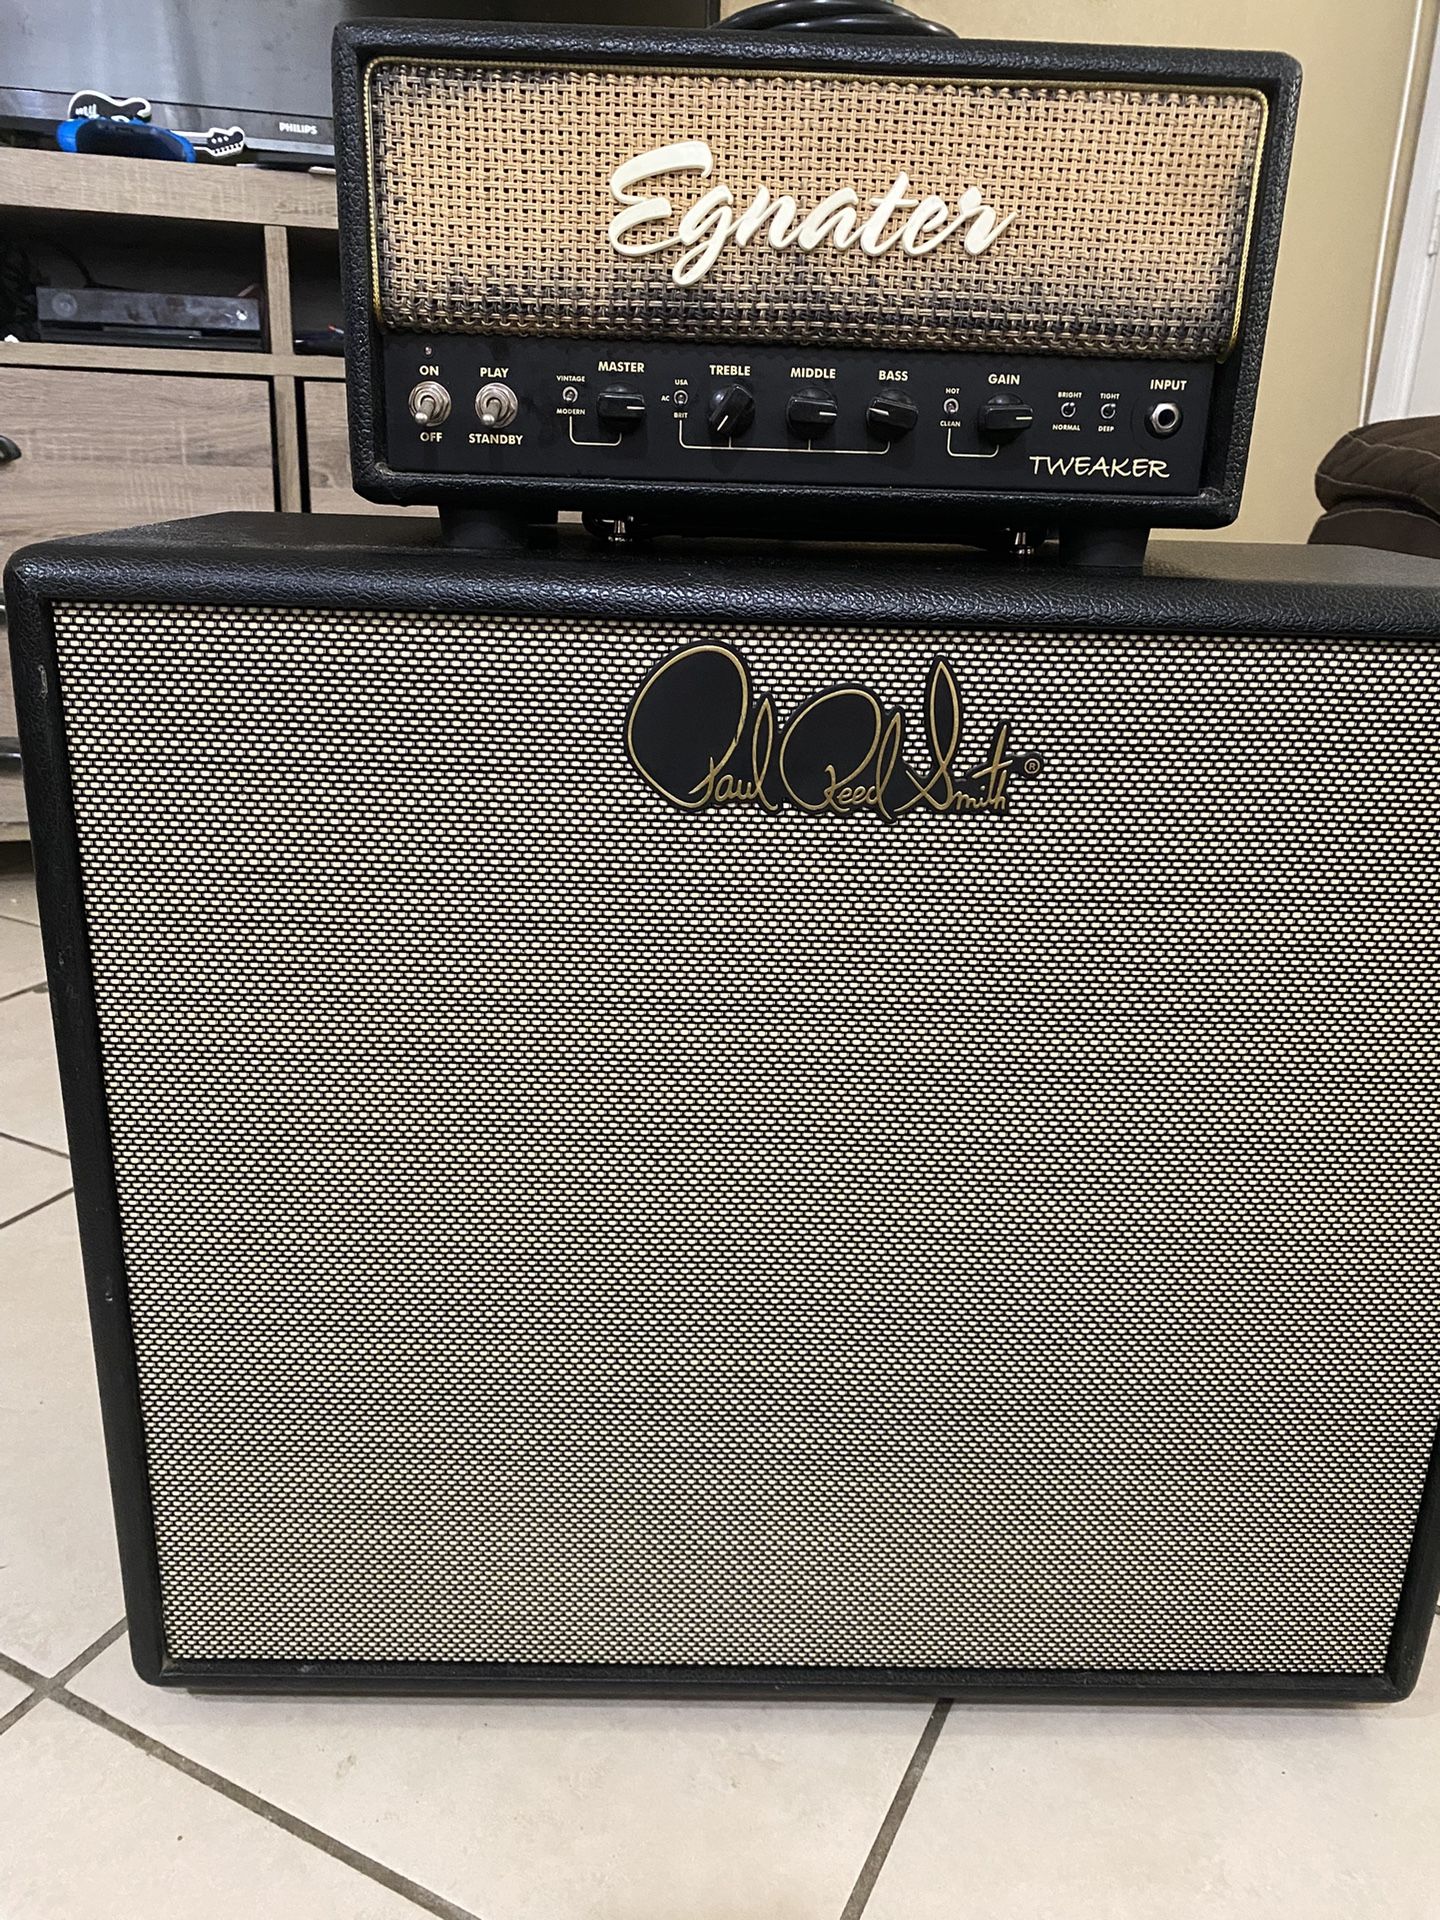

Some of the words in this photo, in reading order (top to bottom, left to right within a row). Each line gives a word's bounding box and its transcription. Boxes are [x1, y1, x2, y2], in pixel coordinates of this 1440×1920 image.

[278, 121, 318, 135] PHILIPS
[608, 140, 1017, 287] Egnater
[419, 365, 439, 377] ON
[480, 367, 509, 378] PLAY
[597, 361, 645, 373] MASTER
[709, 364, 751, 377] TREBLE
[790, 367, 836, 379] MIDDLE
[556, 375, 586, 383] VINTAGE
[878, 370, 909, 382] BASS
[988, 373, 1021, 385] GAIN
[945, 387, 960, 395] HOT
[1149, 379, 1188, 391] INPUT
[1057, 391, 1083, 399] BRIGHT
[1100, 392, 1120, 400] TIGHT
[556, 408, 586, 416] MODERN
[673, 412, 688, 420] BRIT
[939, 420, 961, 429] CLEAN
[419, 431, 443, 443] OFF
[468, 433, 524, 445] STANDBY
[1029, 455, 1170, 478] TWEAKER
[628, 645, 777, 809] Paul
[780, 689, 901, 819] Reed
[893, 661, 1013, 811] Smith
